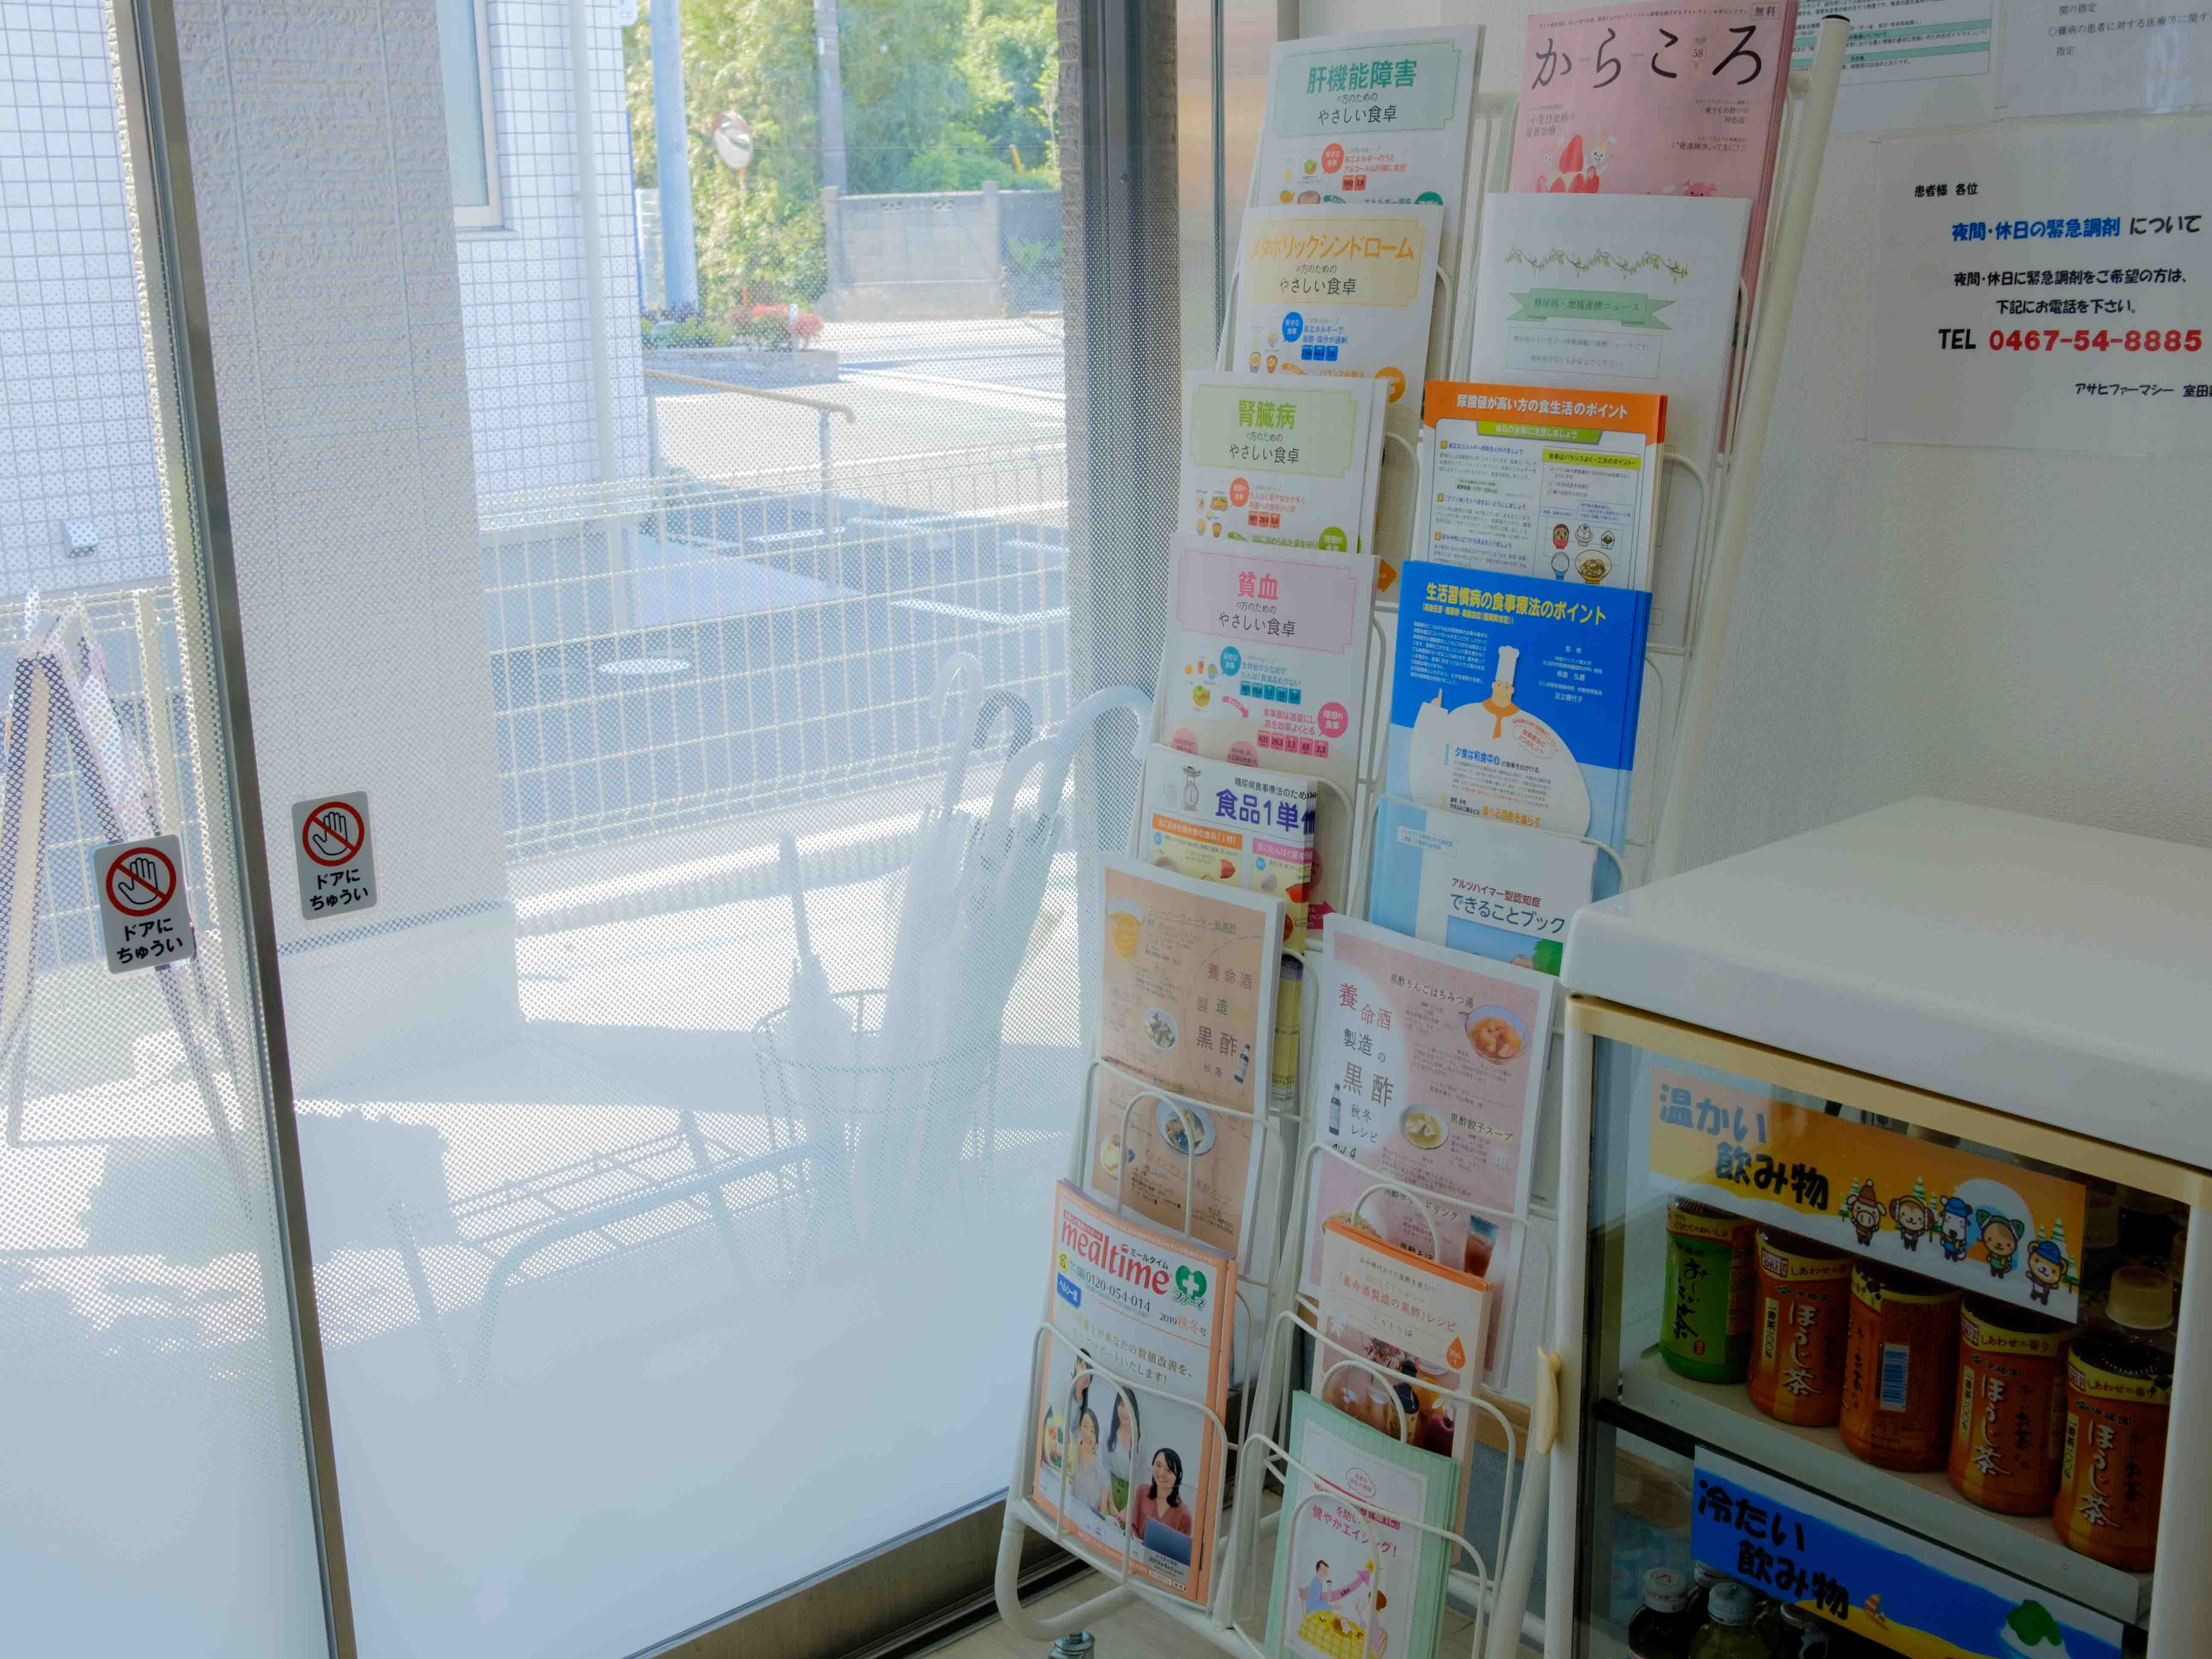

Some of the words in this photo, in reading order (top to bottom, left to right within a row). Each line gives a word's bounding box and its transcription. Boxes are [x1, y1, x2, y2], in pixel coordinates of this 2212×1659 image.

[1754, 6, 1776, 17] 無料
[1531, 25, 1762, 90] からころ
[1692, 49, 1704, 58] 58
[2056, 46, 2075, 56] 指定
[1306, 59, 1417, 94] 肝機能障害
[1337, 92, 1378, 103] の方のための
[1318, 105, 1397, 125] やさしい食卓
[1914, 184, 1948, 198] 患者様
[1955, 182, 1978, 196] 各位
[1951, 217, 2121, 242] 夜間・休日の緊急調剤
[2129, 214, 2202, 235] について
[1296, 264, 1337, 274] の方のための
[1954, 268, 2187, 287] 夜間・休日に緊急調剤をご希望の方は、
[1279, 277, 1357, 295] やさしい食卓
[1996, 299, 2136, 315] 下記にお電話を下さい。
[1939, 328, 1976, 350] TEL
[1989, 330, 2202, 352] 0467-54-8885
[2075, 383, 2174, 396] アサヒファーマシー
[1238, 399, 1296, 430] 腎臓病
[1457, 394, 1628, 419] 尿酸値が高い方の食生活のポイント
[1246, 431, 1283, 442] の方のための
[1229, 444, 1299, 464] やさしい食卓
[1237, 571, 1278, 601] 貧血
[1236, 601, 1277, 614] の方のための
[1425, 582, 1607, 626] 生活習慣病の食事療法のポイント
[1218, 611, 1296, 637] やさしい食卓
[316, 868, 361, 890] ドアに
[308, 887, 369, 911] ちゅうい
[1452, 877, 1541, 908] アルツハイマー型認知症
[1450, 894, 1565, 934] できることブック
[123, 917, 173, 941] ドアに
[116, 937, 183, 964] ちゅうい
[1339, 982, 1393, 1032] 養命酒
[1195, 1025, 1238, 1058] 黒酢
[1343, 1061, 1394, 1108] 黒酢
[1350, 1103, 1372, 1124] 秋冬
[1659, 1083, 1766, 1143] 温かい
[1349, 1125, 1379, 1143] レシピ
[1715, 1141, 1829, 1211] 飲み物
[1061, 1219, 1170, 1296] mealtime
[1130, 1247, 1170, 1271] ミールタイム
[1173, 1288, 1206, 1309] ファーマ
[1783, 1303, 1823, 1396] ほうじ茶
[1972, 1373, 2014, 1477] ほうじ茶
[2077, 1419, 2124, 1528] ほうじ茶
[1697, 1479, 1805, 1551] 冷たい
[1737, 1539, 1849, 1621] 飲み物
